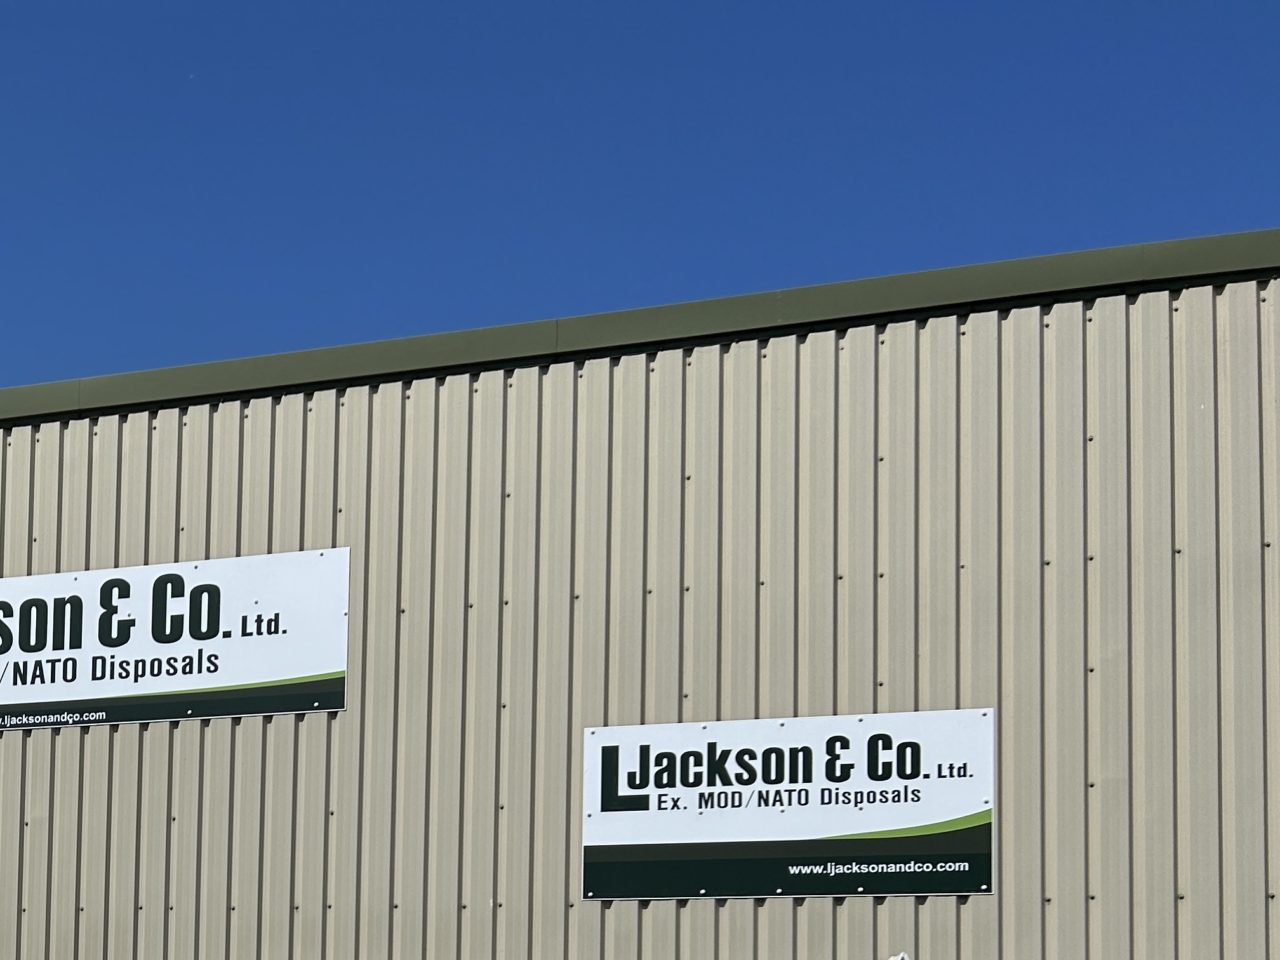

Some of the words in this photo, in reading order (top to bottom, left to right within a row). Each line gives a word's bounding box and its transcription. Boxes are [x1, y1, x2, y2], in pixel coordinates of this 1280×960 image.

[97, 577, 136, 648] &
[150, 572, 232, 643] Co.
[240, 612, 288, 638] Ltd.
[91, 647, 220, 682] Disposals
[825, 735, 856, 783] &
[866, 733, 930, 781] Co.
[937, 762, 974, 779] Ltd.
[657, 793, 688, 811] Ex.
[697, 788, 810, 810] MOD/NATO
[820, 785, 922, 808] Disposals
[788, 860, 970, 877] www.ljacksonandco.com
